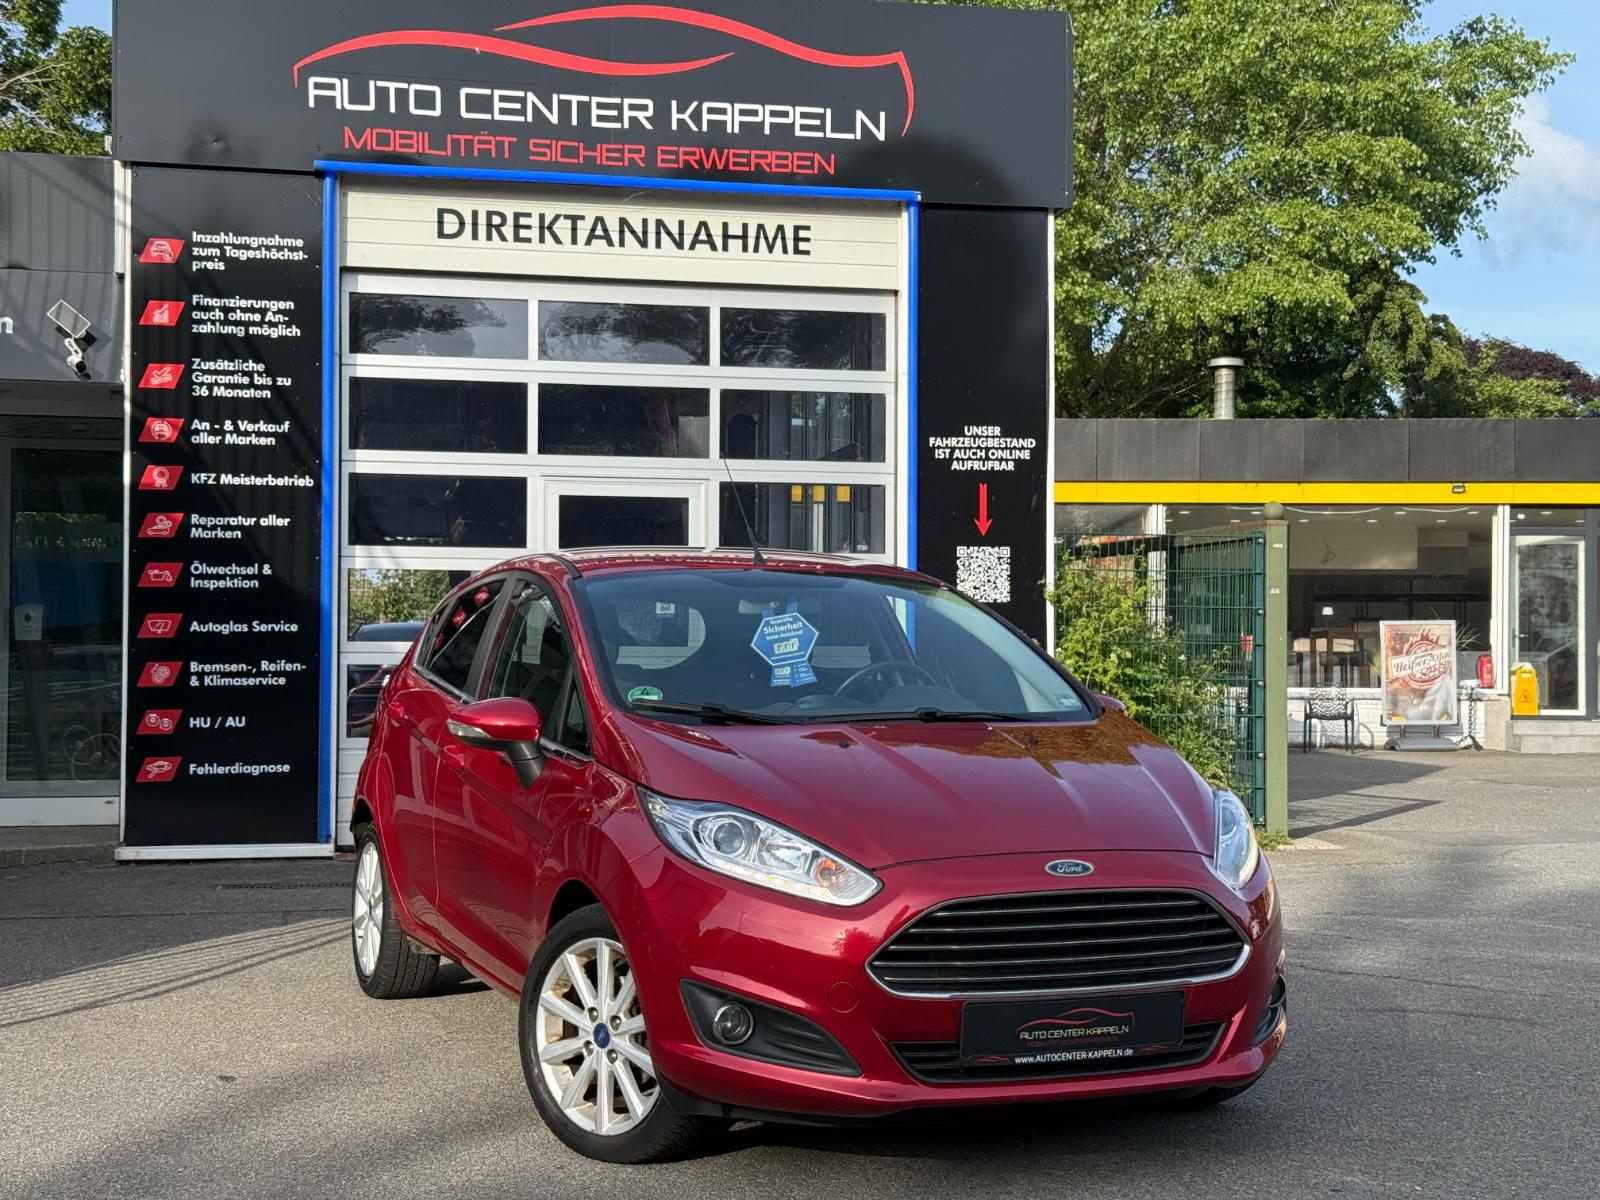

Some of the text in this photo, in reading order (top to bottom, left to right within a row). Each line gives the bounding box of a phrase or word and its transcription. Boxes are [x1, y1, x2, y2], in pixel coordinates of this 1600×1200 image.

[307, 76, 886, 142] AUTO CENTER KAPPELN
[343, 127, 836, 176] MOBILITÄT SICHER ERWERBEN
[436, 207, 812, 256] DIREKTANNAHME
[191, 230, 305, 249] Inzahlungnahme
[191, 245, 309, 262] zum Tageshöchst-
[191, 257, 226, 272] preis
[191, 294, 295, 311] Finanzierungen
[191, 307, 290, 323] auch ohne An-
[191, 321, 301, 339] zahlung möglich
[191, 357, 266, 372] Zusätzliche
[191, 371, 292, 387] Garantie bis zu
[191, 384, 272, 399] 36 Monaten
[190, 419, 211, 431] An
[223, 419, 235, 432] &
[237, 419, 291, 434] Verkauf
[964, 425, 1001, 436] UNSER
[190, 431, 276, 446] aller Marken
[929, 437, 1036, 449] FAHRZEUGBESTAND
[935, 448, 1031, 460] IST AUCH ONLINE
[951, 460, 1015, 471] AUFRUFBAR
[191, 472, 315, 487] KFZ Meisterbetrieb
[190, 513, 291, 528] Reparatur aller
[190, 527, 242, 539] Marken
[190, 560, 273, 575] Ölwechsel &
[190, 576, 260, 590] Inspektion
[189, 620, 299, 635] Autoglas Service
[763, 621, 803, 635] Sicherheit
[190, 659, 307, 674] Bremsen-, Reifen-
[189, 673, 287, 687] & Klimaservice
[189, 716, 246, 729] HU / AU
[189, 762, 291, 777] Fehlerdiagnose
[1057, 862, 1083, 873] Ford
[1020, 1025, 1129, 1040] AUTO CENTER KAPPELN
[1015, 1047, 1134, 1063] www.AUTOCENTER-KAPPELN.de
